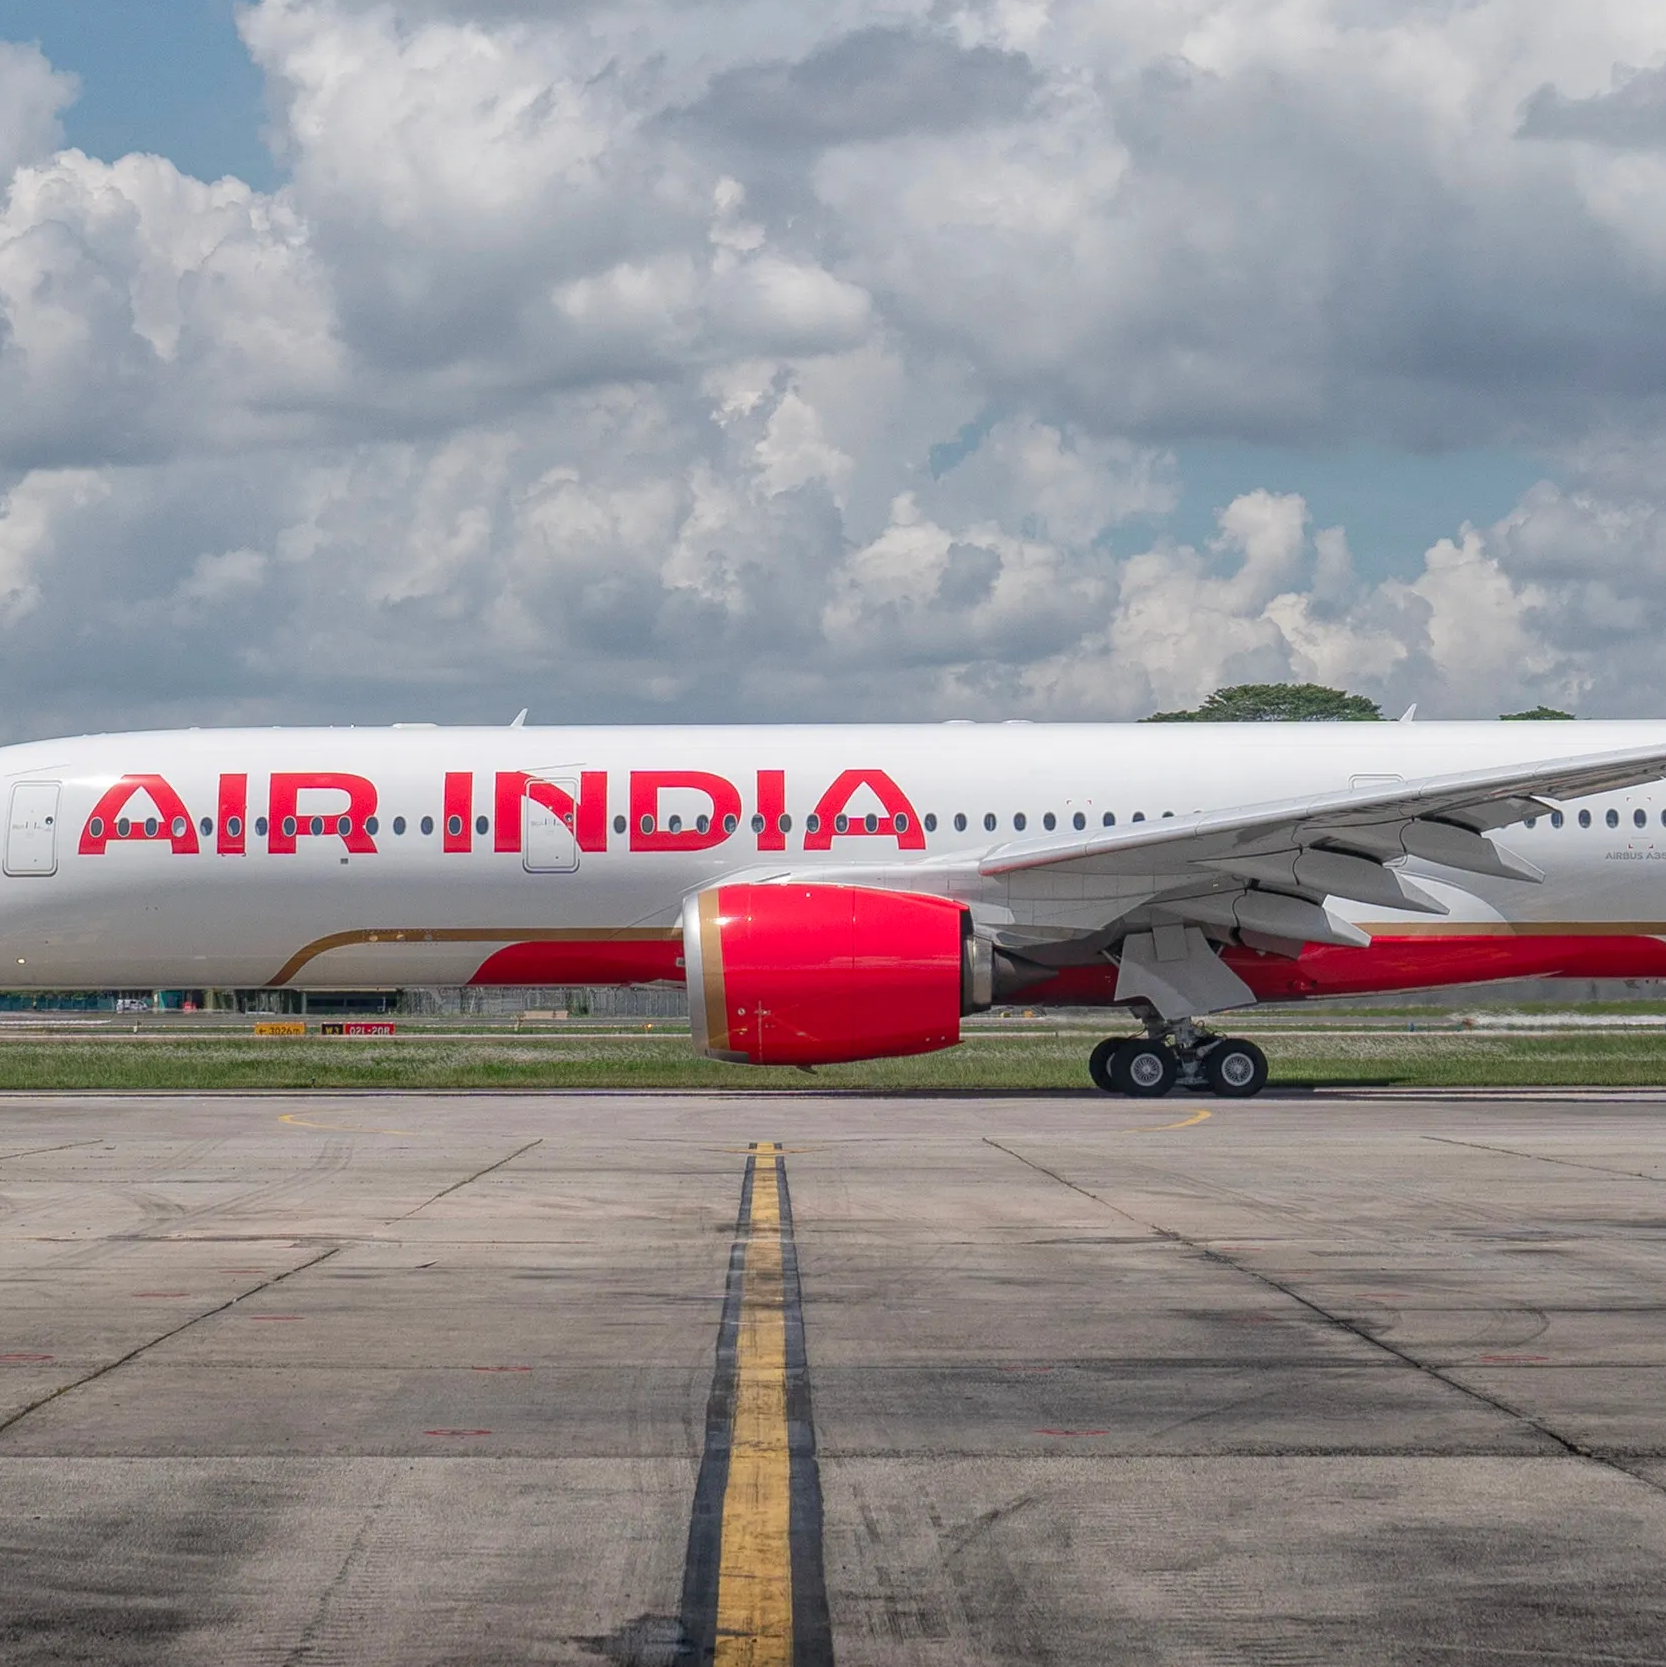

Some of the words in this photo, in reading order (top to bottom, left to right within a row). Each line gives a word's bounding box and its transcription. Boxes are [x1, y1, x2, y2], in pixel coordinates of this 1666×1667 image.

[78, 772, 378, 854] AIR
[443, 769, 927, 853] INDIA
[1605, 852, 1643, 860] AIRBUS
[269, 1026, 301, 1035] 3026m
